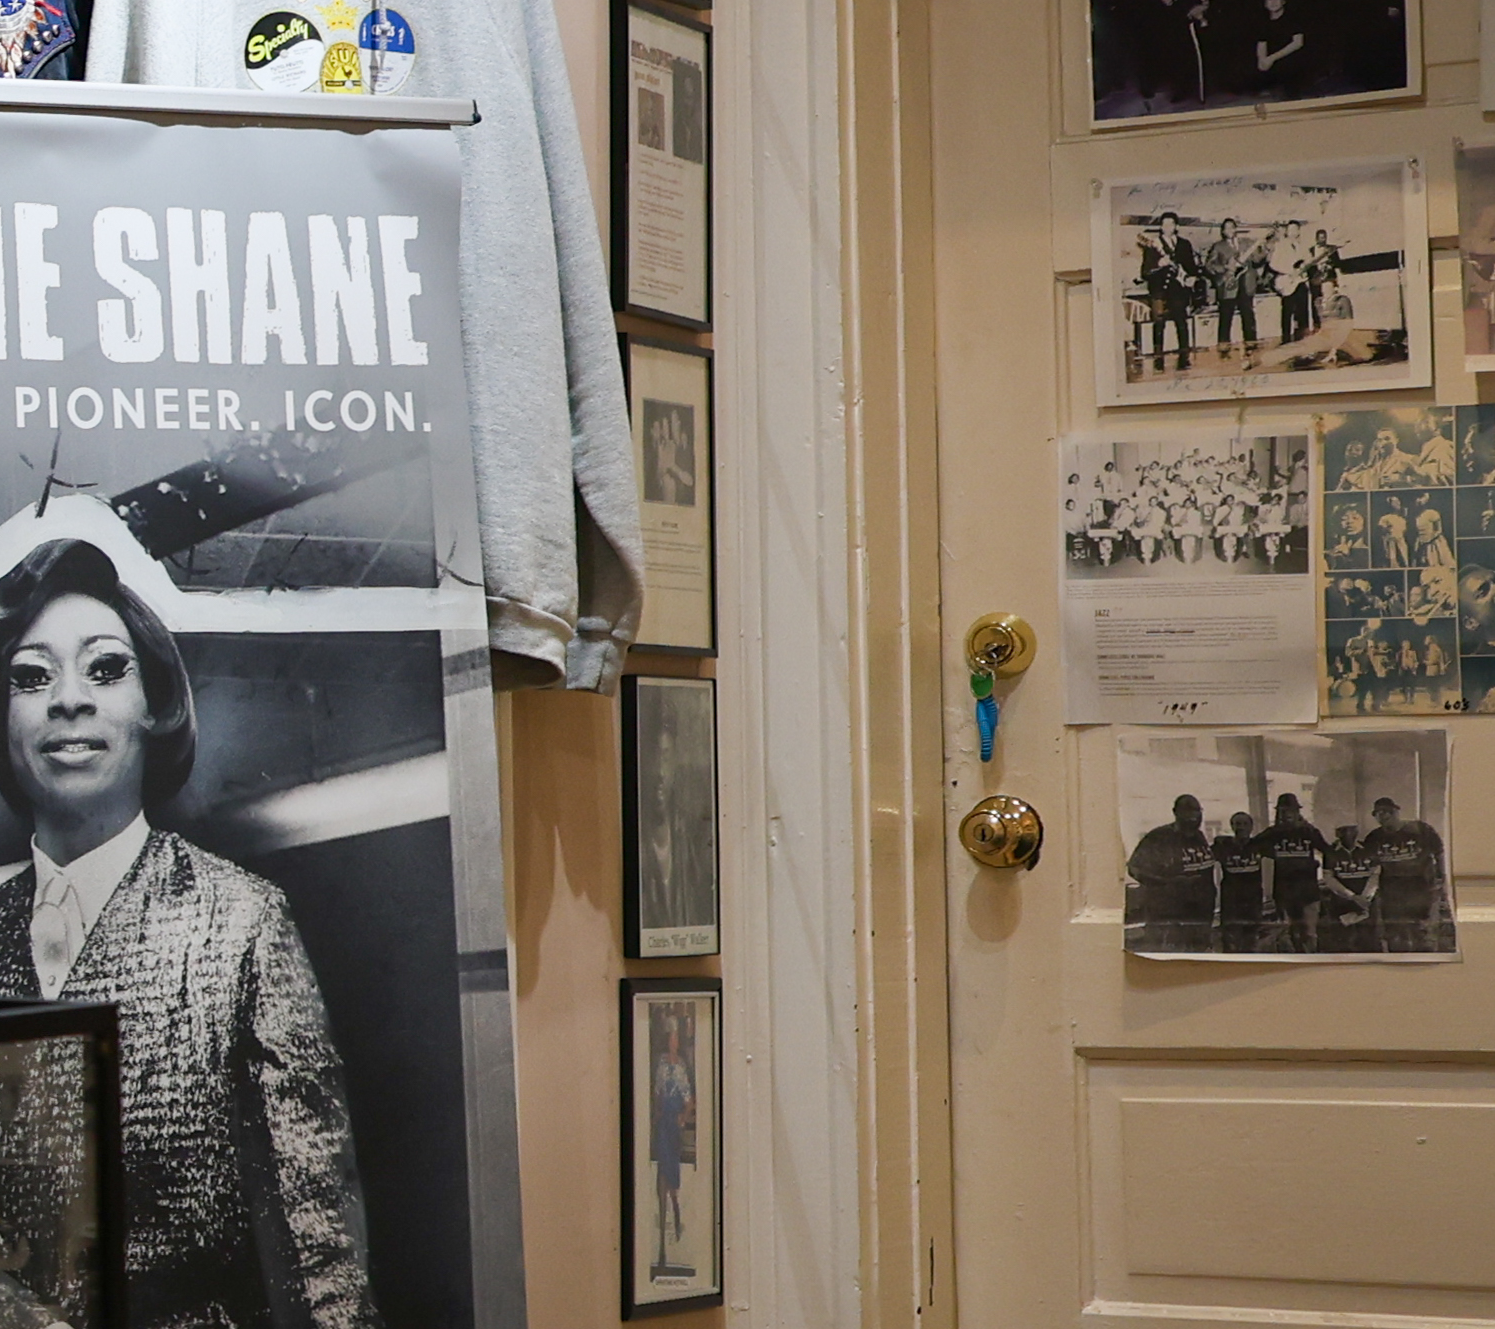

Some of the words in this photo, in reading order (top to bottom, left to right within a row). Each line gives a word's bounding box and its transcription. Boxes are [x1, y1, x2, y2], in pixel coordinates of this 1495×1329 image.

[248, 17, 310, 63] Specialty
[92, 204, 430, 367] SHANE
[15, 384, 262, 432] PIONEER.
[284, 389, 433, 433] ICON.
